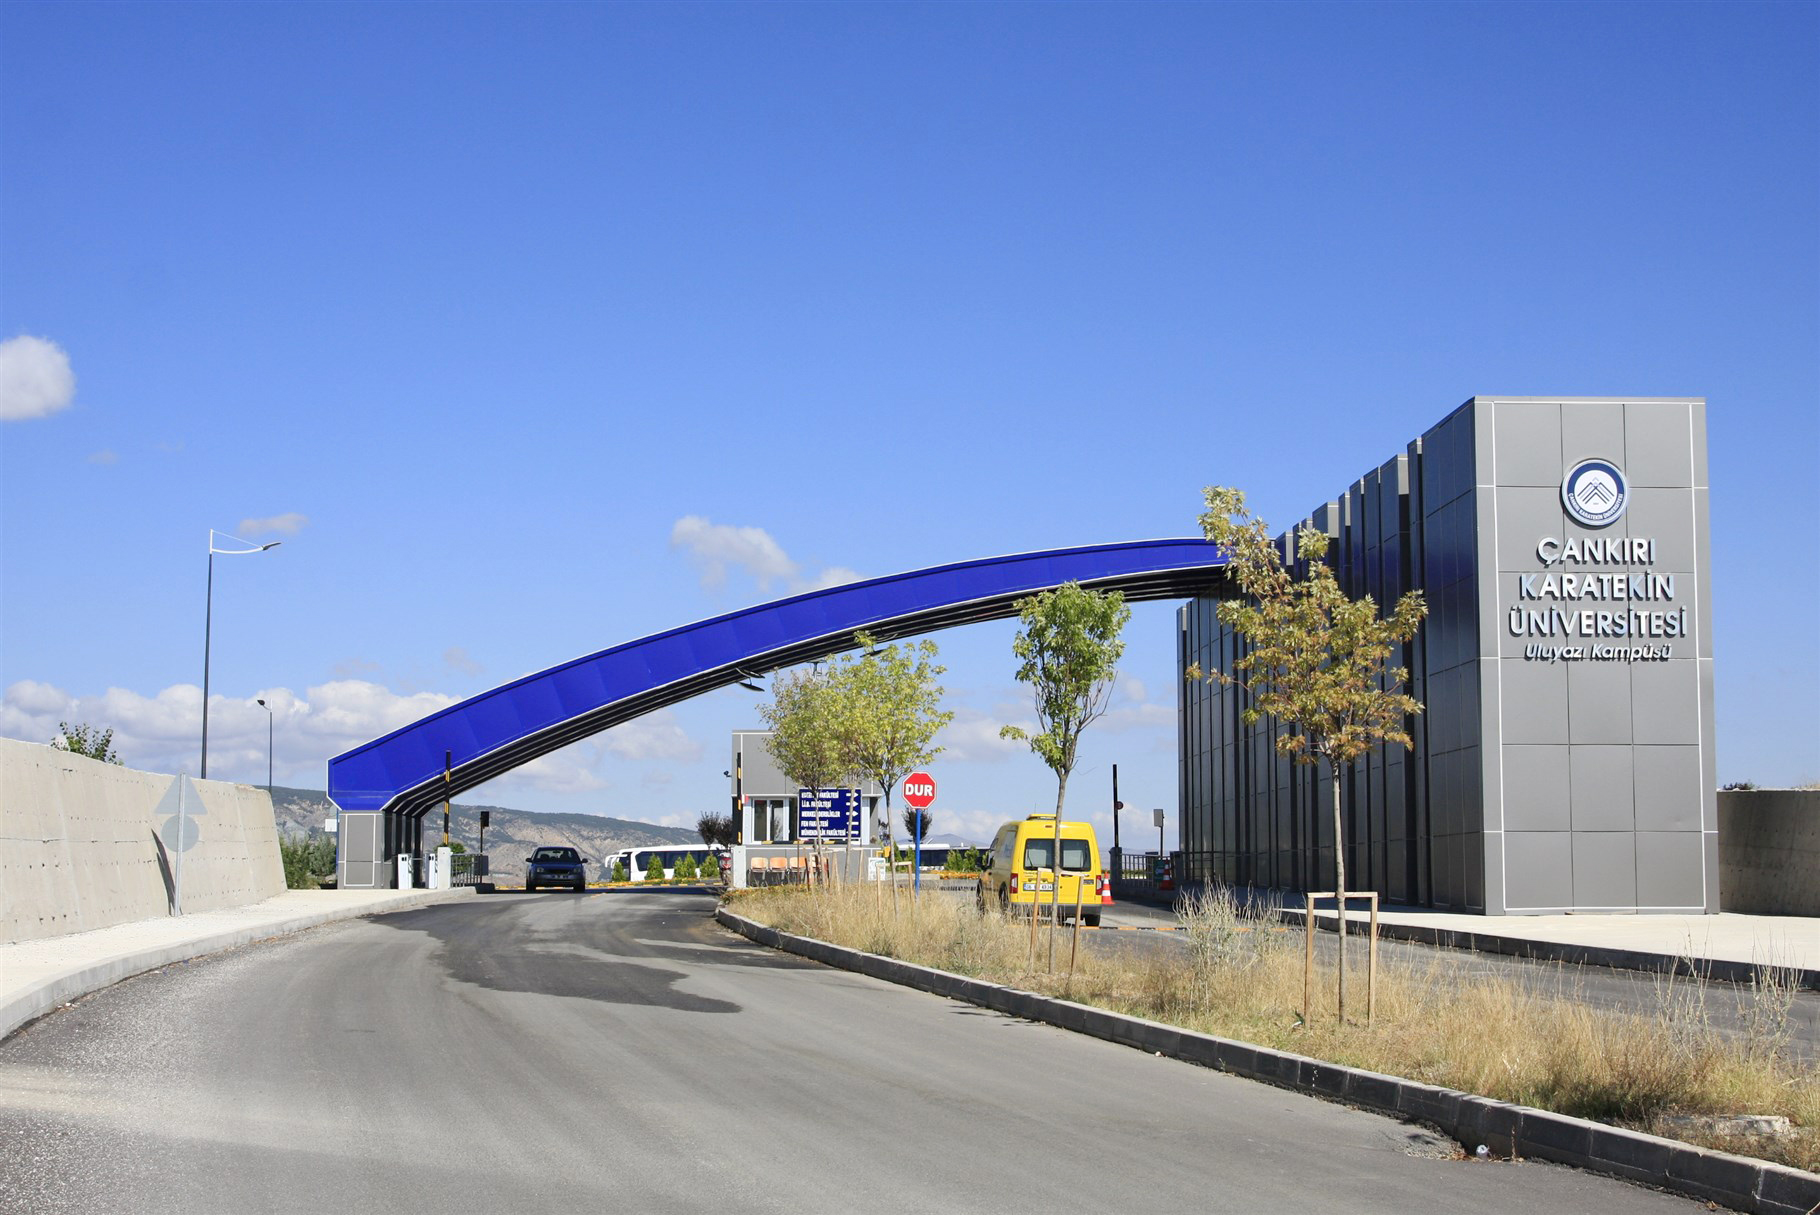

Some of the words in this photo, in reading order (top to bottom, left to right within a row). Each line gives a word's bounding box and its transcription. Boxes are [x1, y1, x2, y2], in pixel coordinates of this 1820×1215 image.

[1537, 537, 1656, 565] ÇANKIRI
[1520, 569, 1674, 599] KARATEKİN
[1509, 604, 1687, 636] ÜNİVERSİTESİ
[1525, 643, 1587, 663] Uluyazı
[1591, 643, 1672, 662] Kampüsü
[905, 783, 933, 797] DUR
